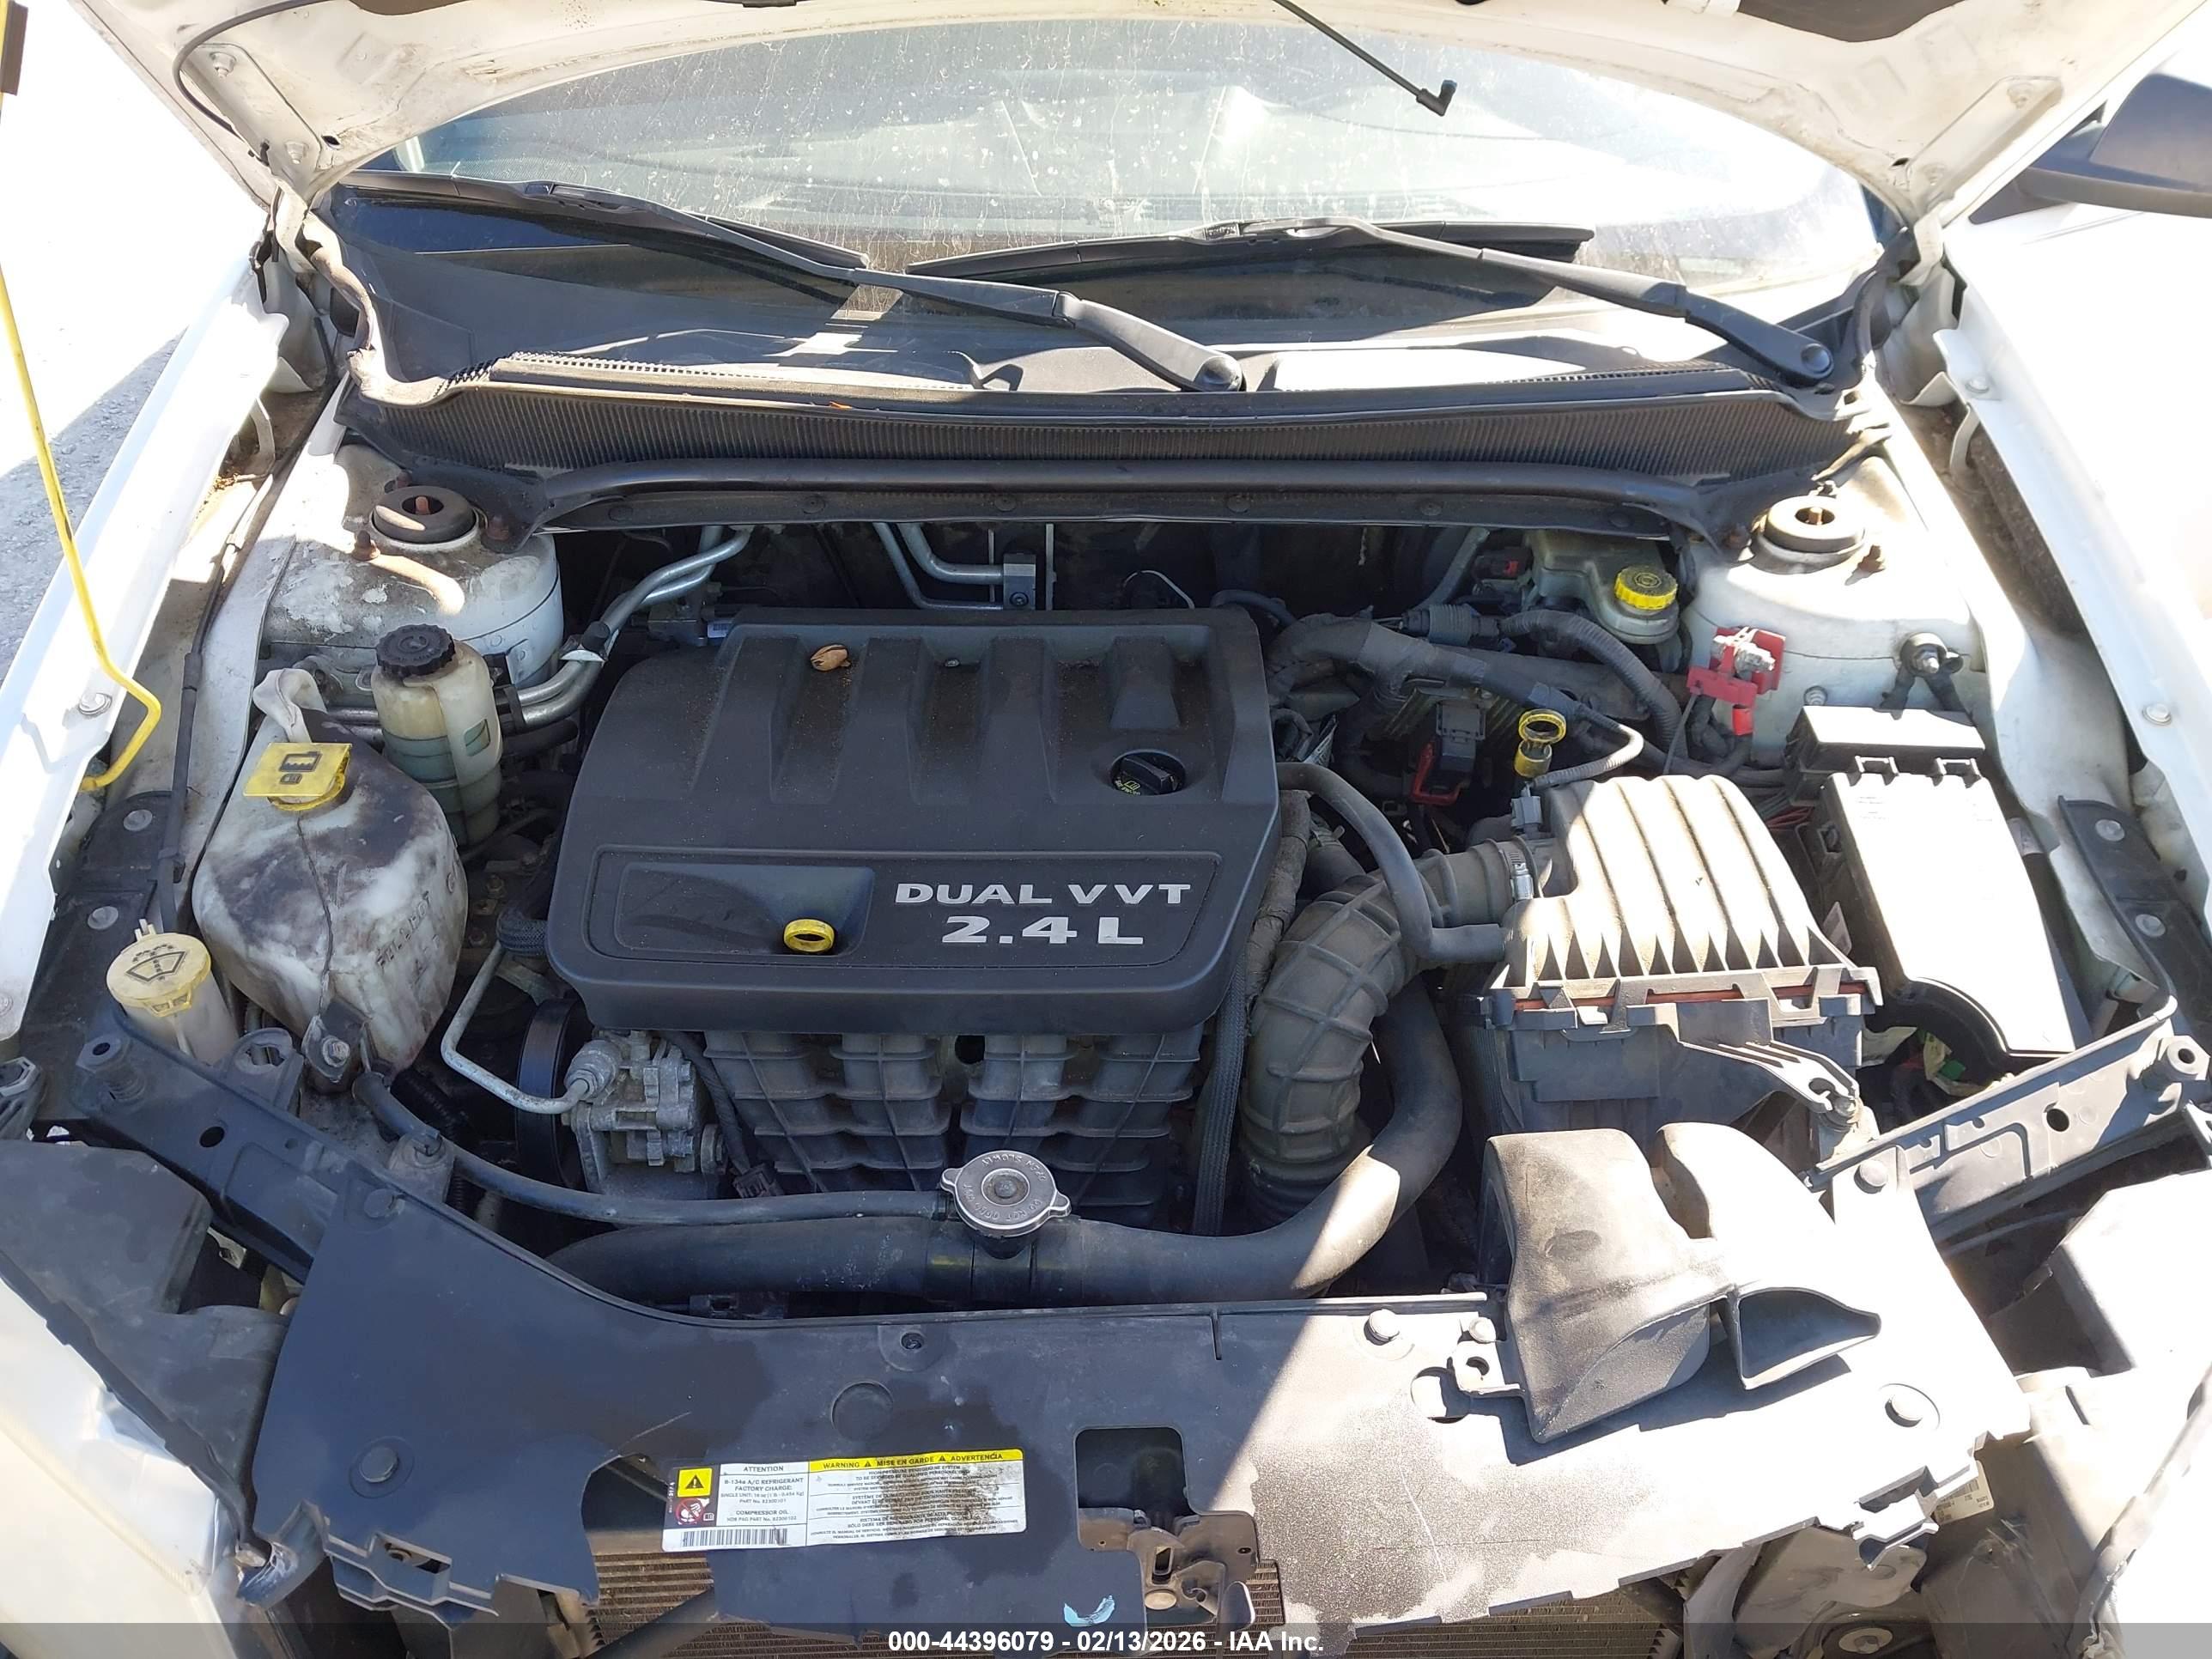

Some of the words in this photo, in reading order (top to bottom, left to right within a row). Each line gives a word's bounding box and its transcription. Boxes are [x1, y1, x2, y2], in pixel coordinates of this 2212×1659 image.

[894, 883, 1053, 904] DUAL
[1066, 883, 1192, 904] VVT
[981, 1153, 1024, 1167] SLOWLY
[908, 1456, 934, 1465] GARDE
